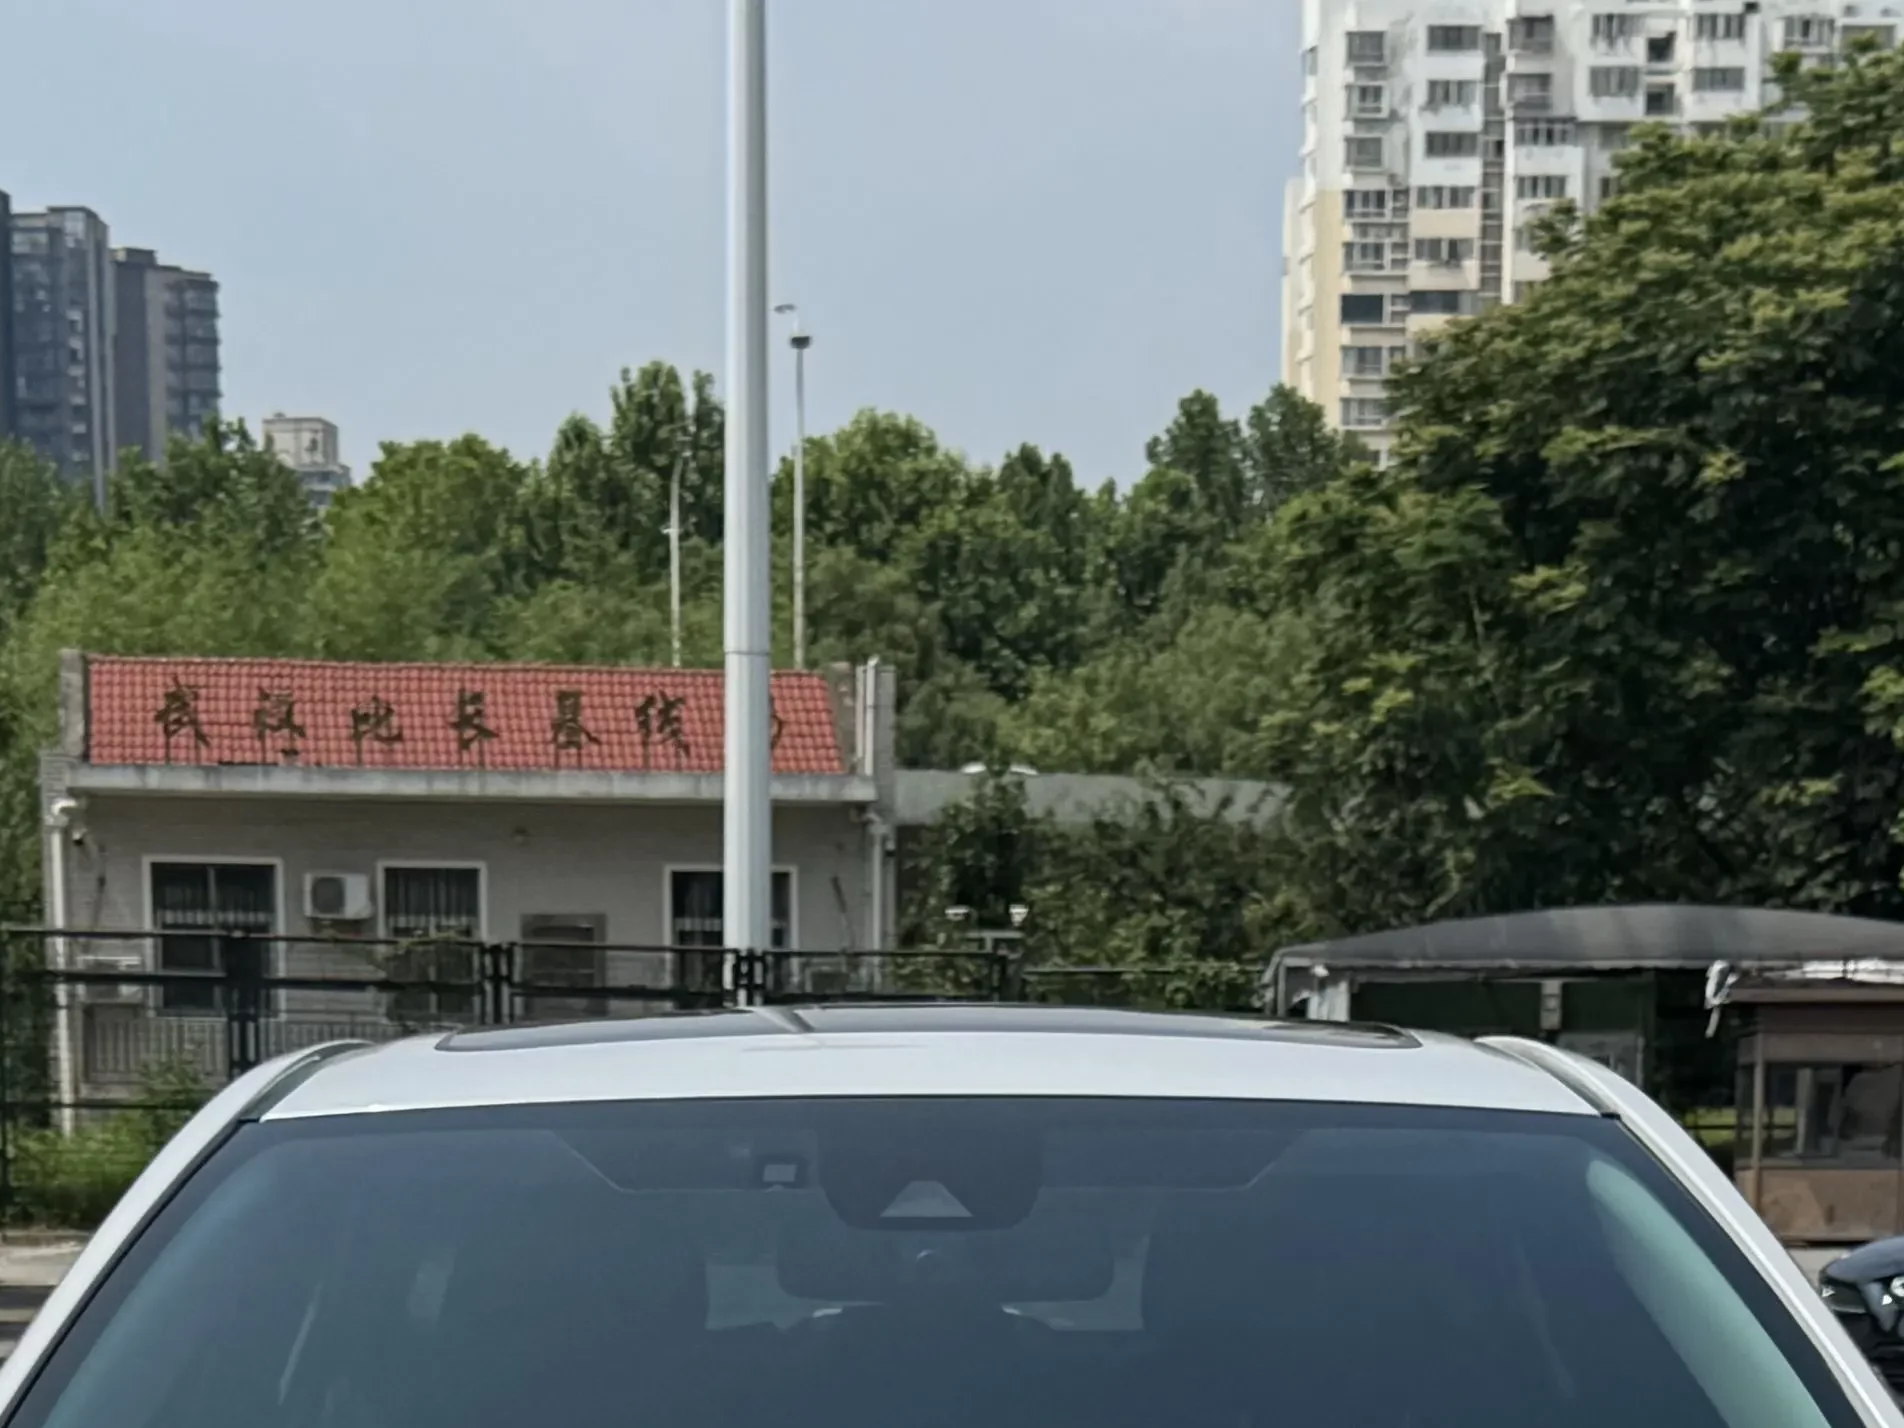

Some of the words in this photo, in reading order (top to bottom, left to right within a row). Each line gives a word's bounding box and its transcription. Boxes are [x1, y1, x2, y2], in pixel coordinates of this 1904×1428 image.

[154, 674, 786, 757] 武汉比长基线
